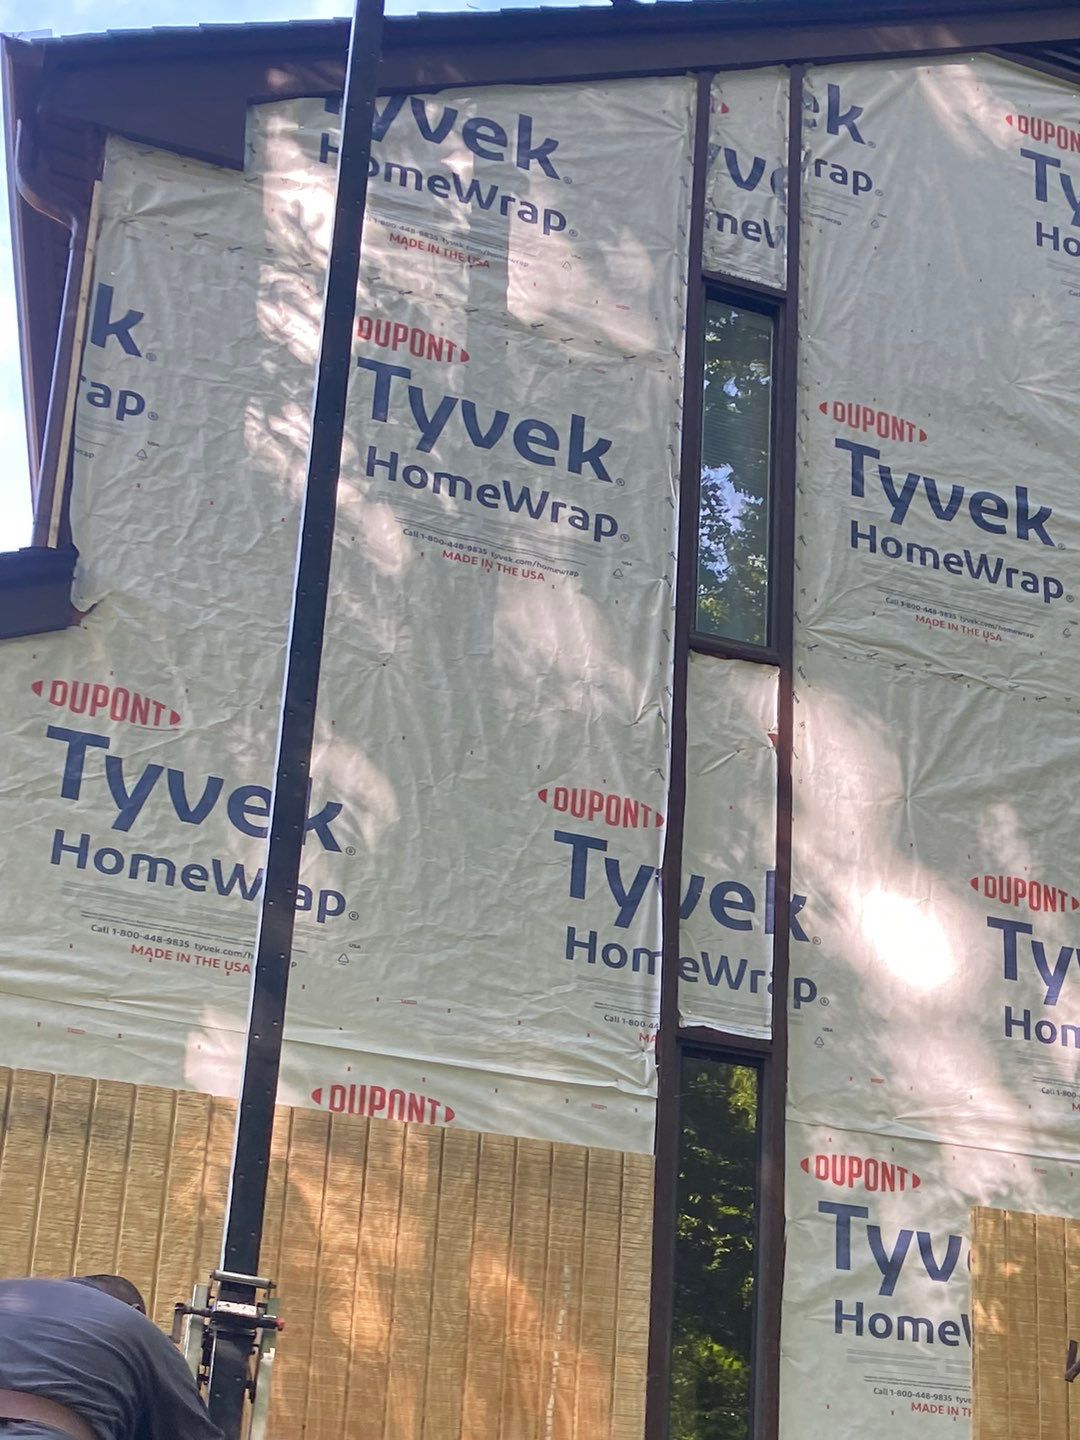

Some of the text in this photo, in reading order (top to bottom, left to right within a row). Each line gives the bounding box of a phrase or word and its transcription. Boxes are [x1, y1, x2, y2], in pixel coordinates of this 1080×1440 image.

[389, 232, 490, 269] MADE IN THE USA
[357, 316, 457, 363] DUPONT
[357, 356, 614, 483] Tyvek
[832, 401, 916, 443] DUPONT
[365, 445, 619, 543] HomeWrap
[834, 437, 1055, 547] Tyvek
[402, 528, 419, 540] Call
[442, 549, 545, 581] MADE IN THE USA
[850, 520, 1064, 603] HomeWrap
[915, 614, 1003, 642] MADE IN THE USA
[47, 680, 167, 727] DUPONT
[553, 786, 653, 829] DUPONT
[50, 828, 347, 924] HomeWap
[983, 875, 1068, 913] DUPONT
[91, 924, 110, 935] Call
[112, 927, 190, 949] 1-800-448-9835
[130, 944, 251, 974] MADE IN THE USA
[603, 1014, 620, 1024] Call
[329, 1084, 441, 1124] DUPONT
[815, 1154, 909, 1192] DUPONT
[873, 1387, 889, 1396] Call
[889, 1389, 953, 1402] 1-800-448-9835
[911, 1402, 944, 1415] MADE
[947, 1406, 959, 1416] IN
